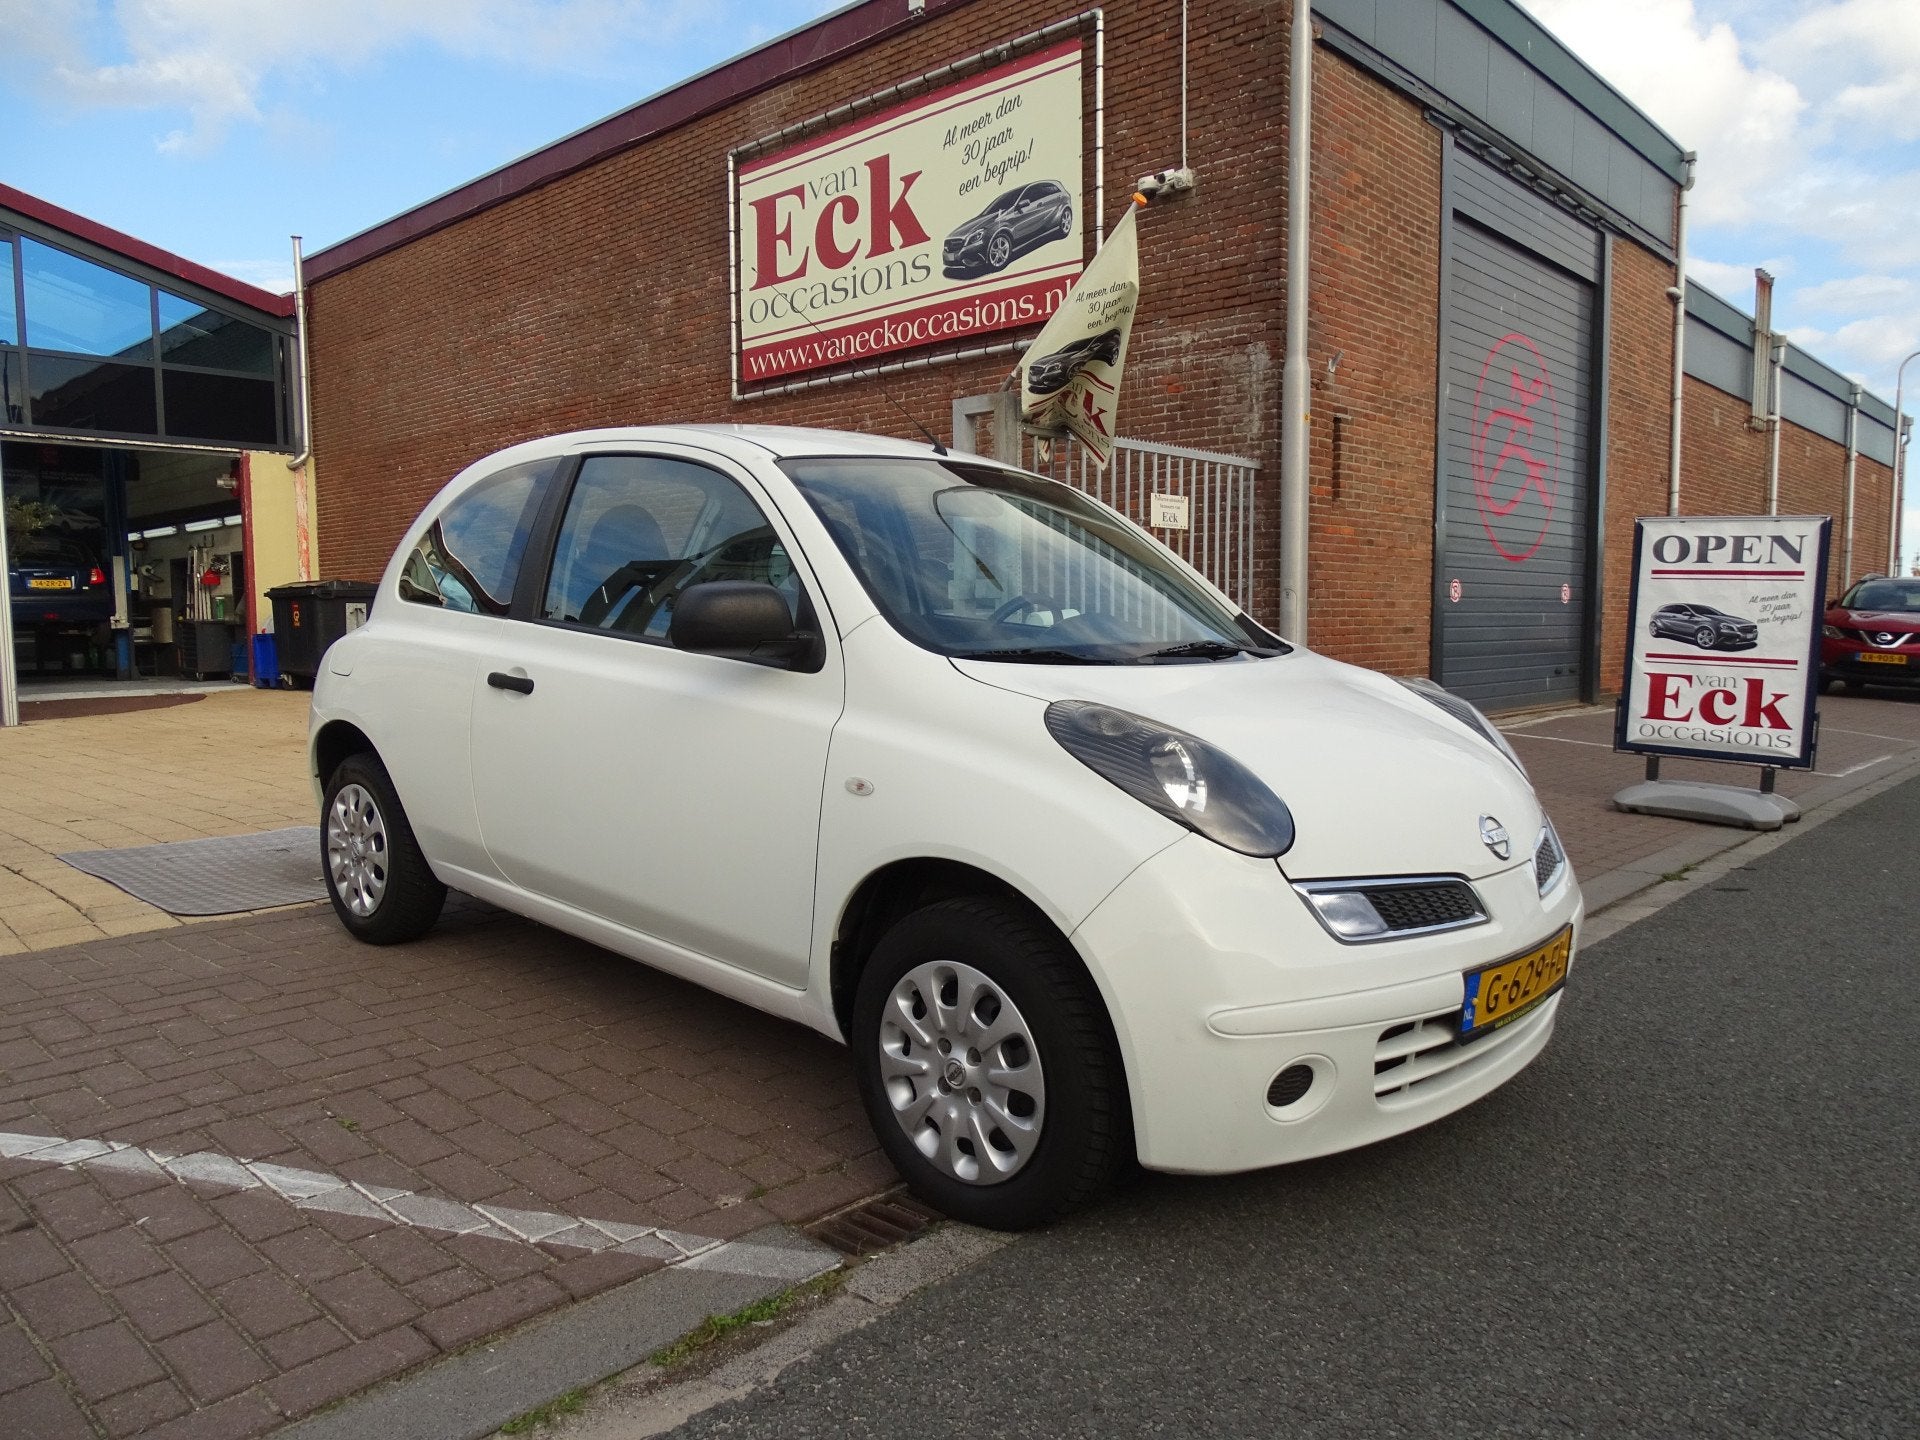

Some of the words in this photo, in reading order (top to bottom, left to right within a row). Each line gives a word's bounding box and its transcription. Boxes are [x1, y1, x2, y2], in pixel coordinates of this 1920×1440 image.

[943, 125, 957, 150] Al
[959, 112, 992, 141] meer
[995, 94, 1022, 120] dan
[961, 140, 981, 165] 30
[980, 126, 1014, 161] jaar
[959, 174, 981, 196] een
[983, 138, 1034, 186] begrip!
[808, 166, 858, 200] van
[749, 153, 931, 291] Eck
[750, 253, 931, 324] occasions
[1076, 291, 1085, 303] Al
[1086, 287, 1108, 300] meer
[1109, 281, 1128, 294] dan
[1087, 301, 1101, 315] 30
[1101, 297, 1122, 316] jaar
[750, 279, 1071, 375] www.vaneckoccasions.nl
[1087, 320, 1103, 330] een
[1162, 511, 1178, 523] Eck
[1652, 534, 1808, 564] OPEN
[1780, 591, 1797, 600] dan
[1759, 603, 1772, 612] 30
[1771, 603, 1791, 615] jaar
[1771, 610, 1803, 625] begrip!
[1696, 674, 1738, 689] van
[1640, 672, 1793, 730] Eck
[1639, 723, 1792, 748] occasions
[1463, 1008, 1473, 1021] NL
